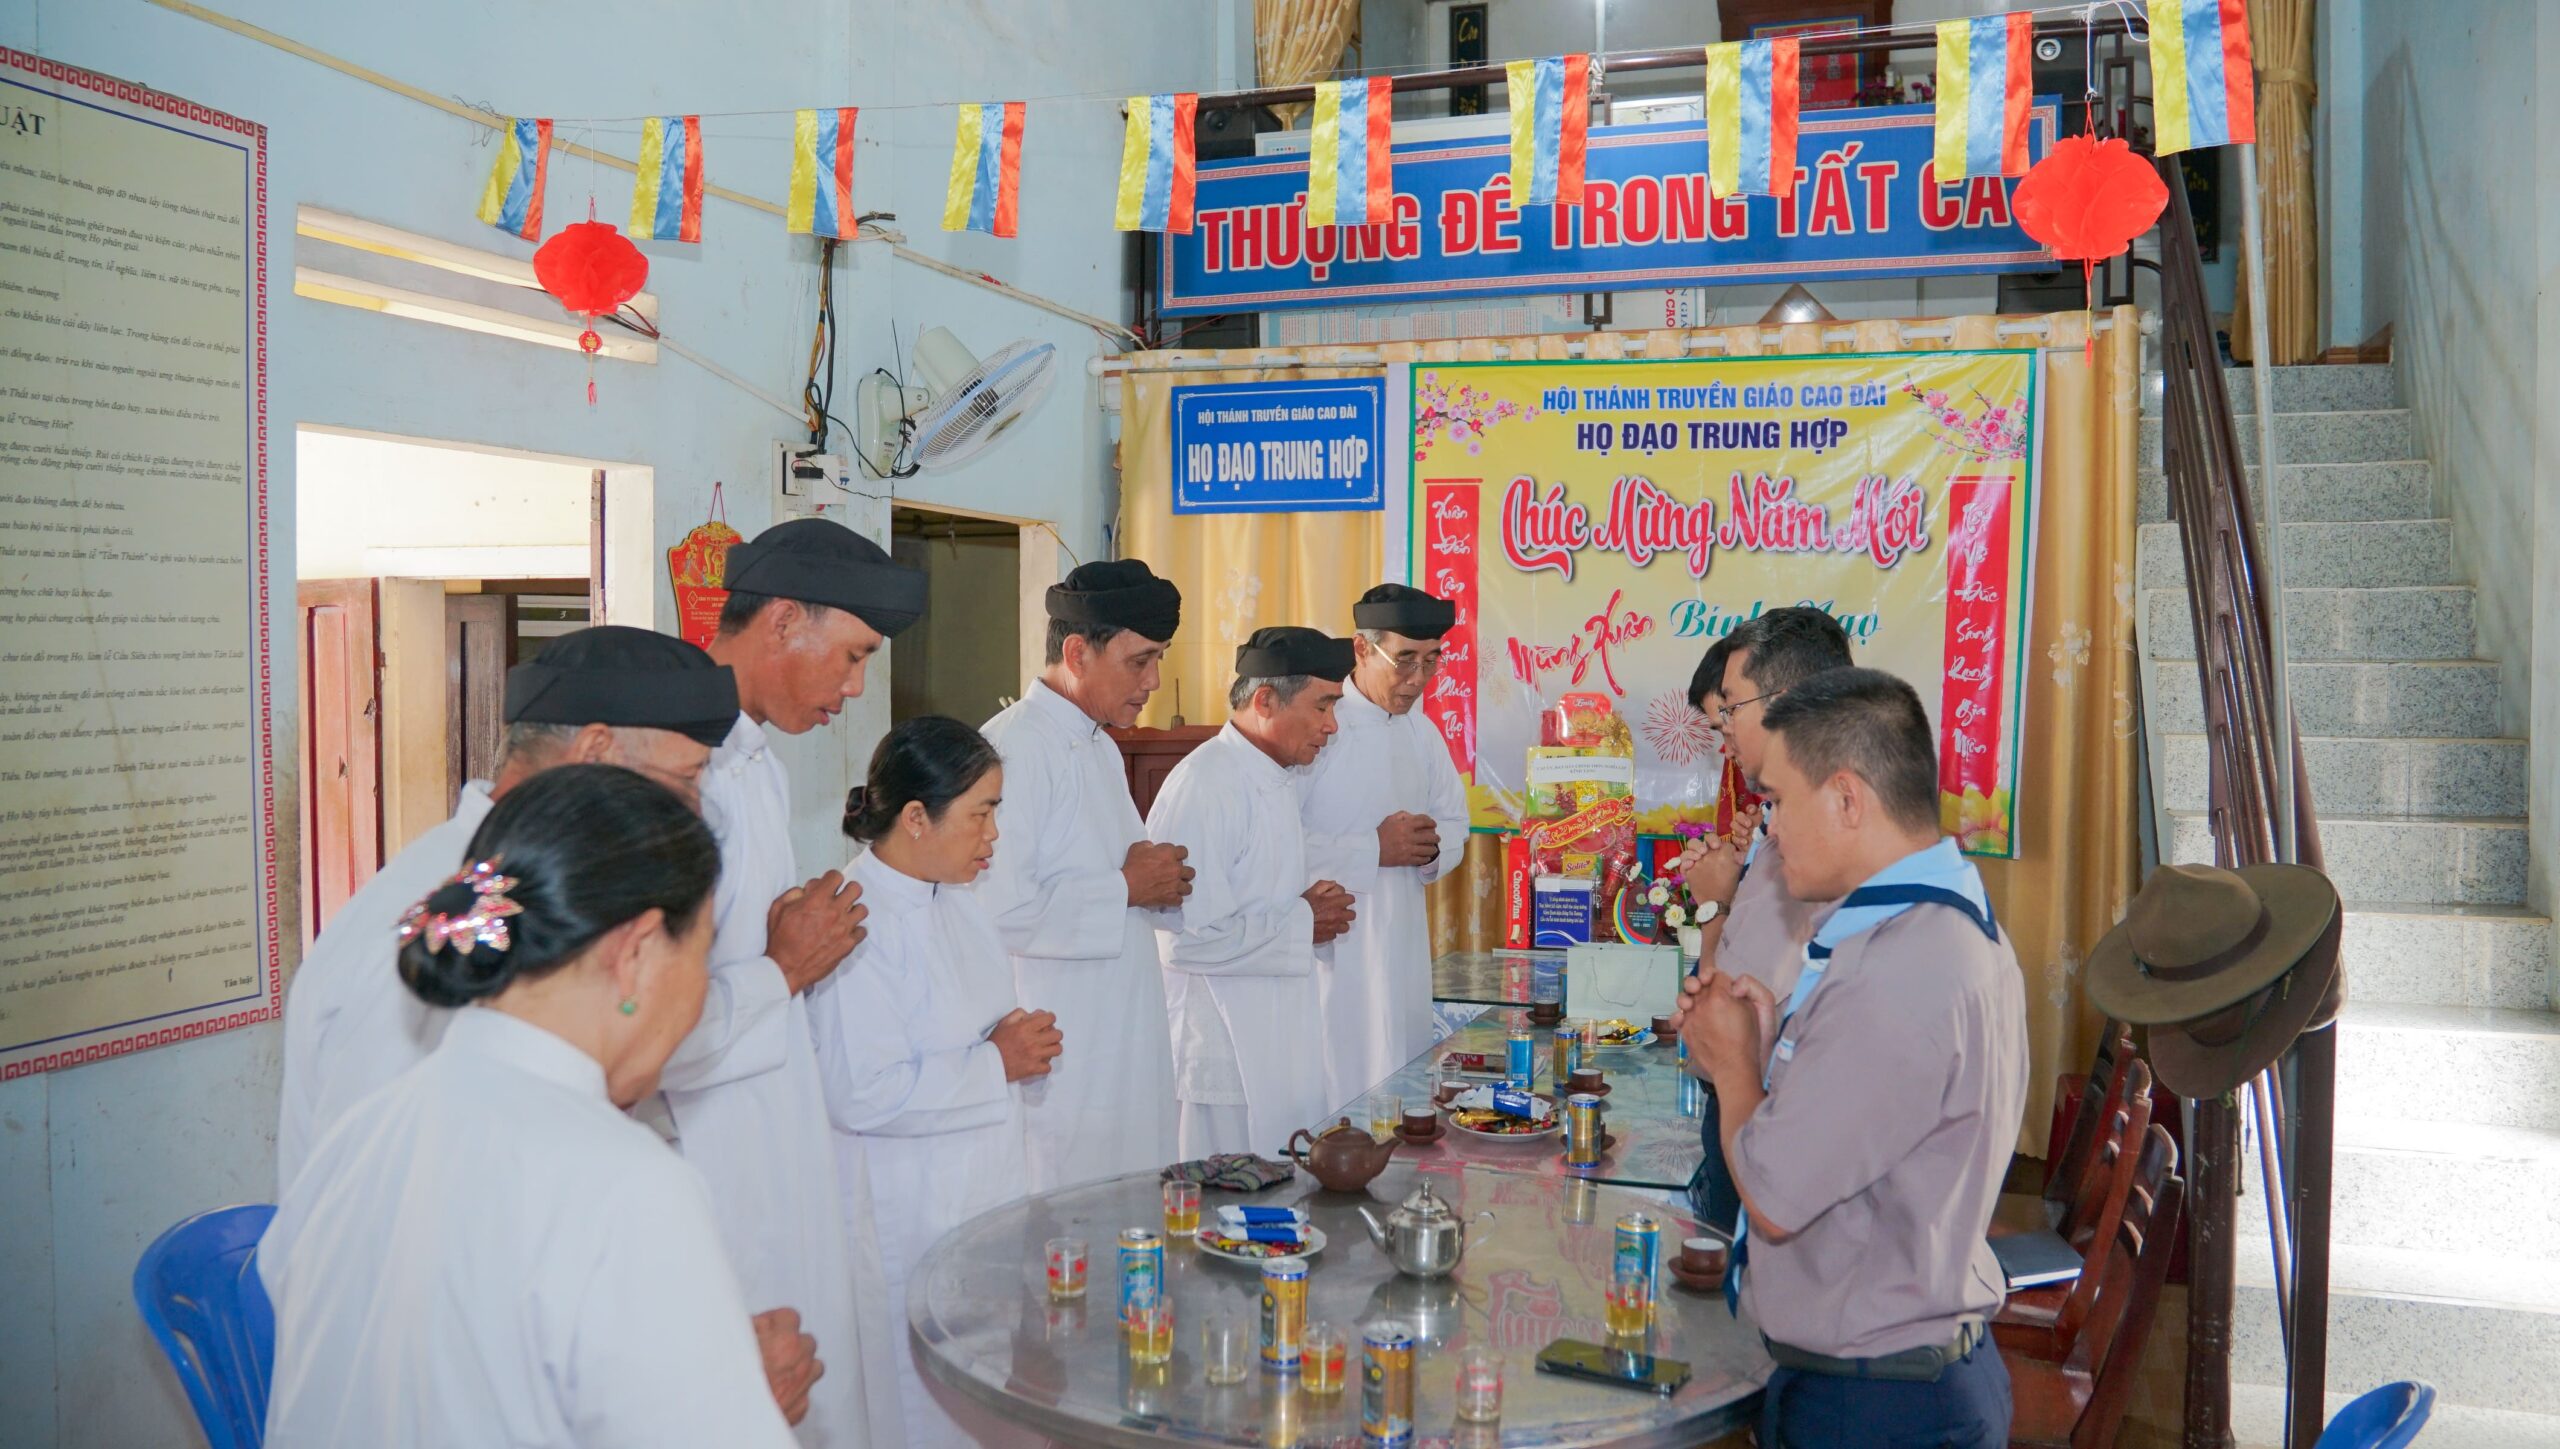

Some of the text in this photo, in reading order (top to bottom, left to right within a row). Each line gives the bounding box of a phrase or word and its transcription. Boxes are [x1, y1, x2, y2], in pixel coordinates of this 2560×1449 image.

[1198, 409, 1214, 427] HỘI
[1217, 408, 1249, 424] THÁNH
[1291, 405, 1314, 421] GIÁO
[1317, 406, 1337, 421] CAO
[1339, 403, 1357, 420] ĐÀI
[1543, 386, 1576, 414] HỘI
[1584, 384, 1650, 410] THÁNH
[1744, 382, 1793, 408] GIÁO
[1800, 385, 1842, 408] CAO
[1850, 380, 1887, 407] ĐÀI
[1577, 417, 1848, 456] HỌ ĐẠO TRUNG HỢP
[1188, 435, 1368, 491] HỌ ĐẠO TRUNG HỢP
[1502, 471, 1928, 582] Chúc Mừng Năm Mới
[1512, 869, 1523, 919] ChocoVina
